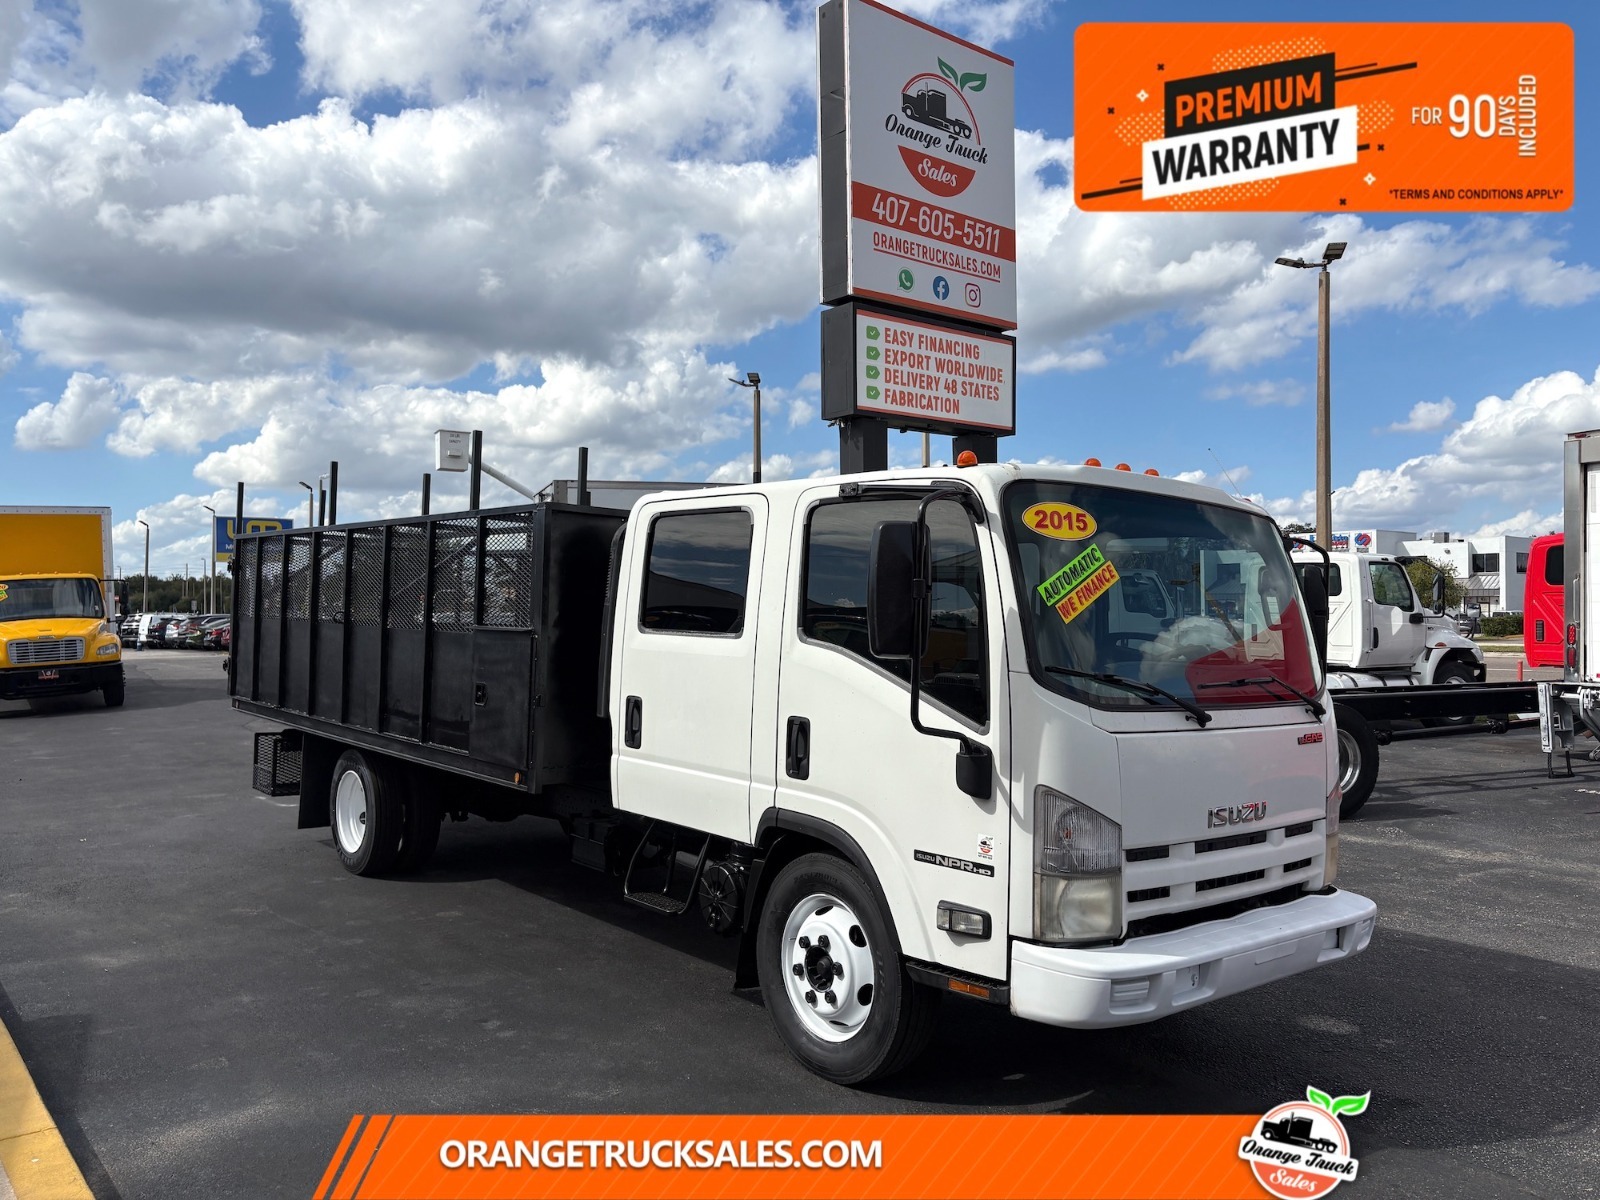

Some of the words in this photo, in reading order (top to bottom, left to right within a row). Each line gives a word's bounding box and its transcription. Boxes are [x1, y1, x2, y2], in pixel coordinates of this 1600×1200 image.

[885, 113, 942, 149] Orange
[945, 135, 989, 165] Truck
[917, 158, 959, 187] Sales
[871, 192, 1001, 254] 407-605-5511
[873, 231, 1001, 279] ORANGETRUCKSALES.COM
[884, 327, 915, 348] EASY
[918, 334, 980, 360] FINANCING
[884, 348, 931, 371] EXPORT
[884, 368, 941, 394] DELIVERY
[943, 379, 958, 395] 48
[961, 382, 1000, 401] STATES
[884, 388, 960, 415] FABRICATION
[1034, 509, 1088, 533] 2015
[1043, 547, 1101, 603] AUTOMATIC
[1057, 596, 1078, 620] WE
[1075, 564, 1116, 606] FINANCE
[1207, 800, 1267, 829] ISUZU
[916, 853, 936, 862] ISUZU
[935, 854, 974, 872] NPR
